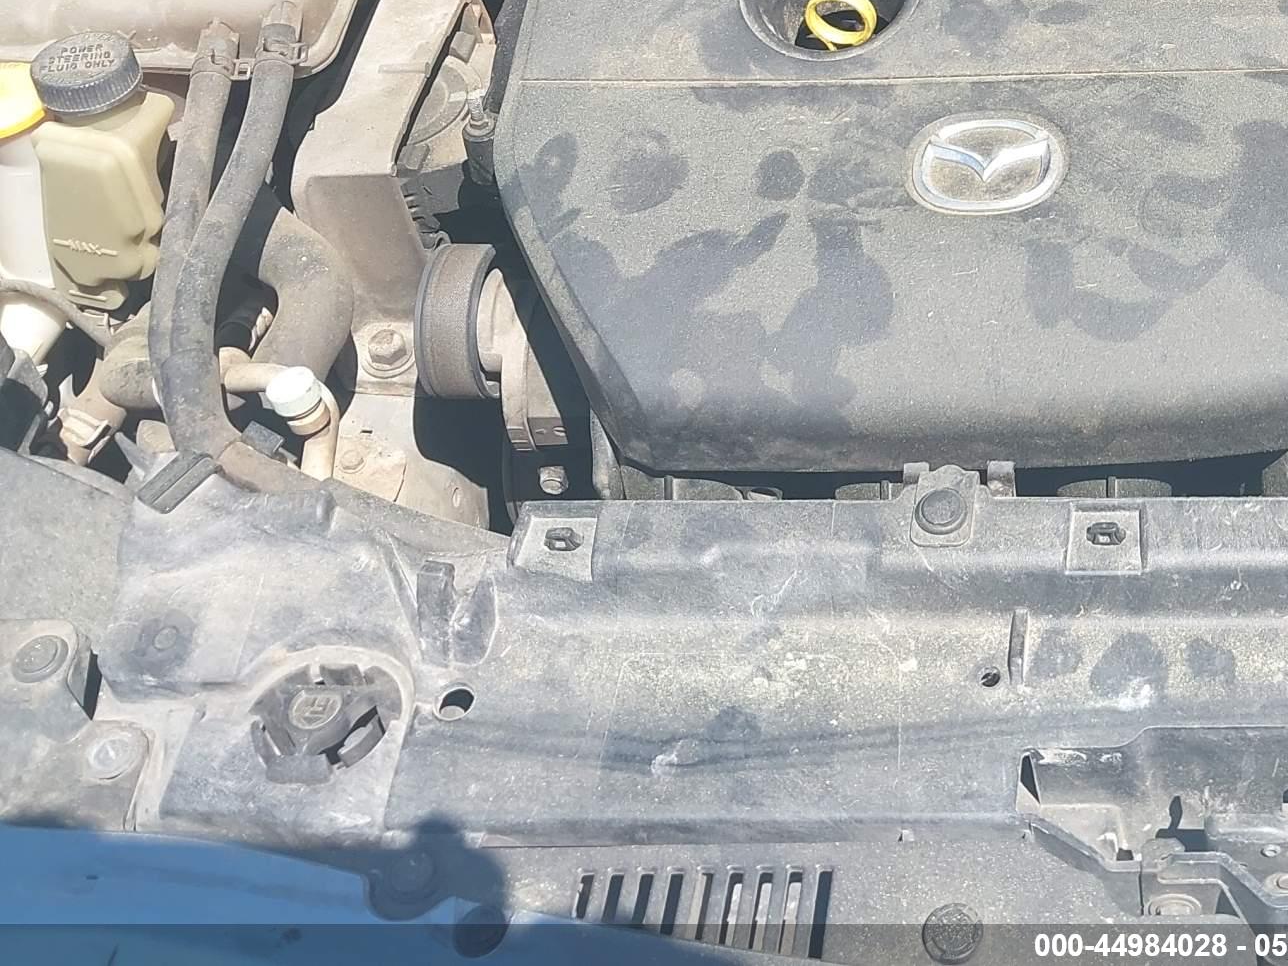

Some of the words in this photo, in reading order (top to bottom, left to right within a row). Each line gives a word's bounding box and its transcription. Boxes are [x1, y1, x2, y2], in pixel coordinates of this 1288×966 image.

[61, 44, 103, 54] POWER
[48, 50, 111, 65] STEERING
[41, 62, 78, 73] FLUID
[84, 58, 116, 69] ONLY
